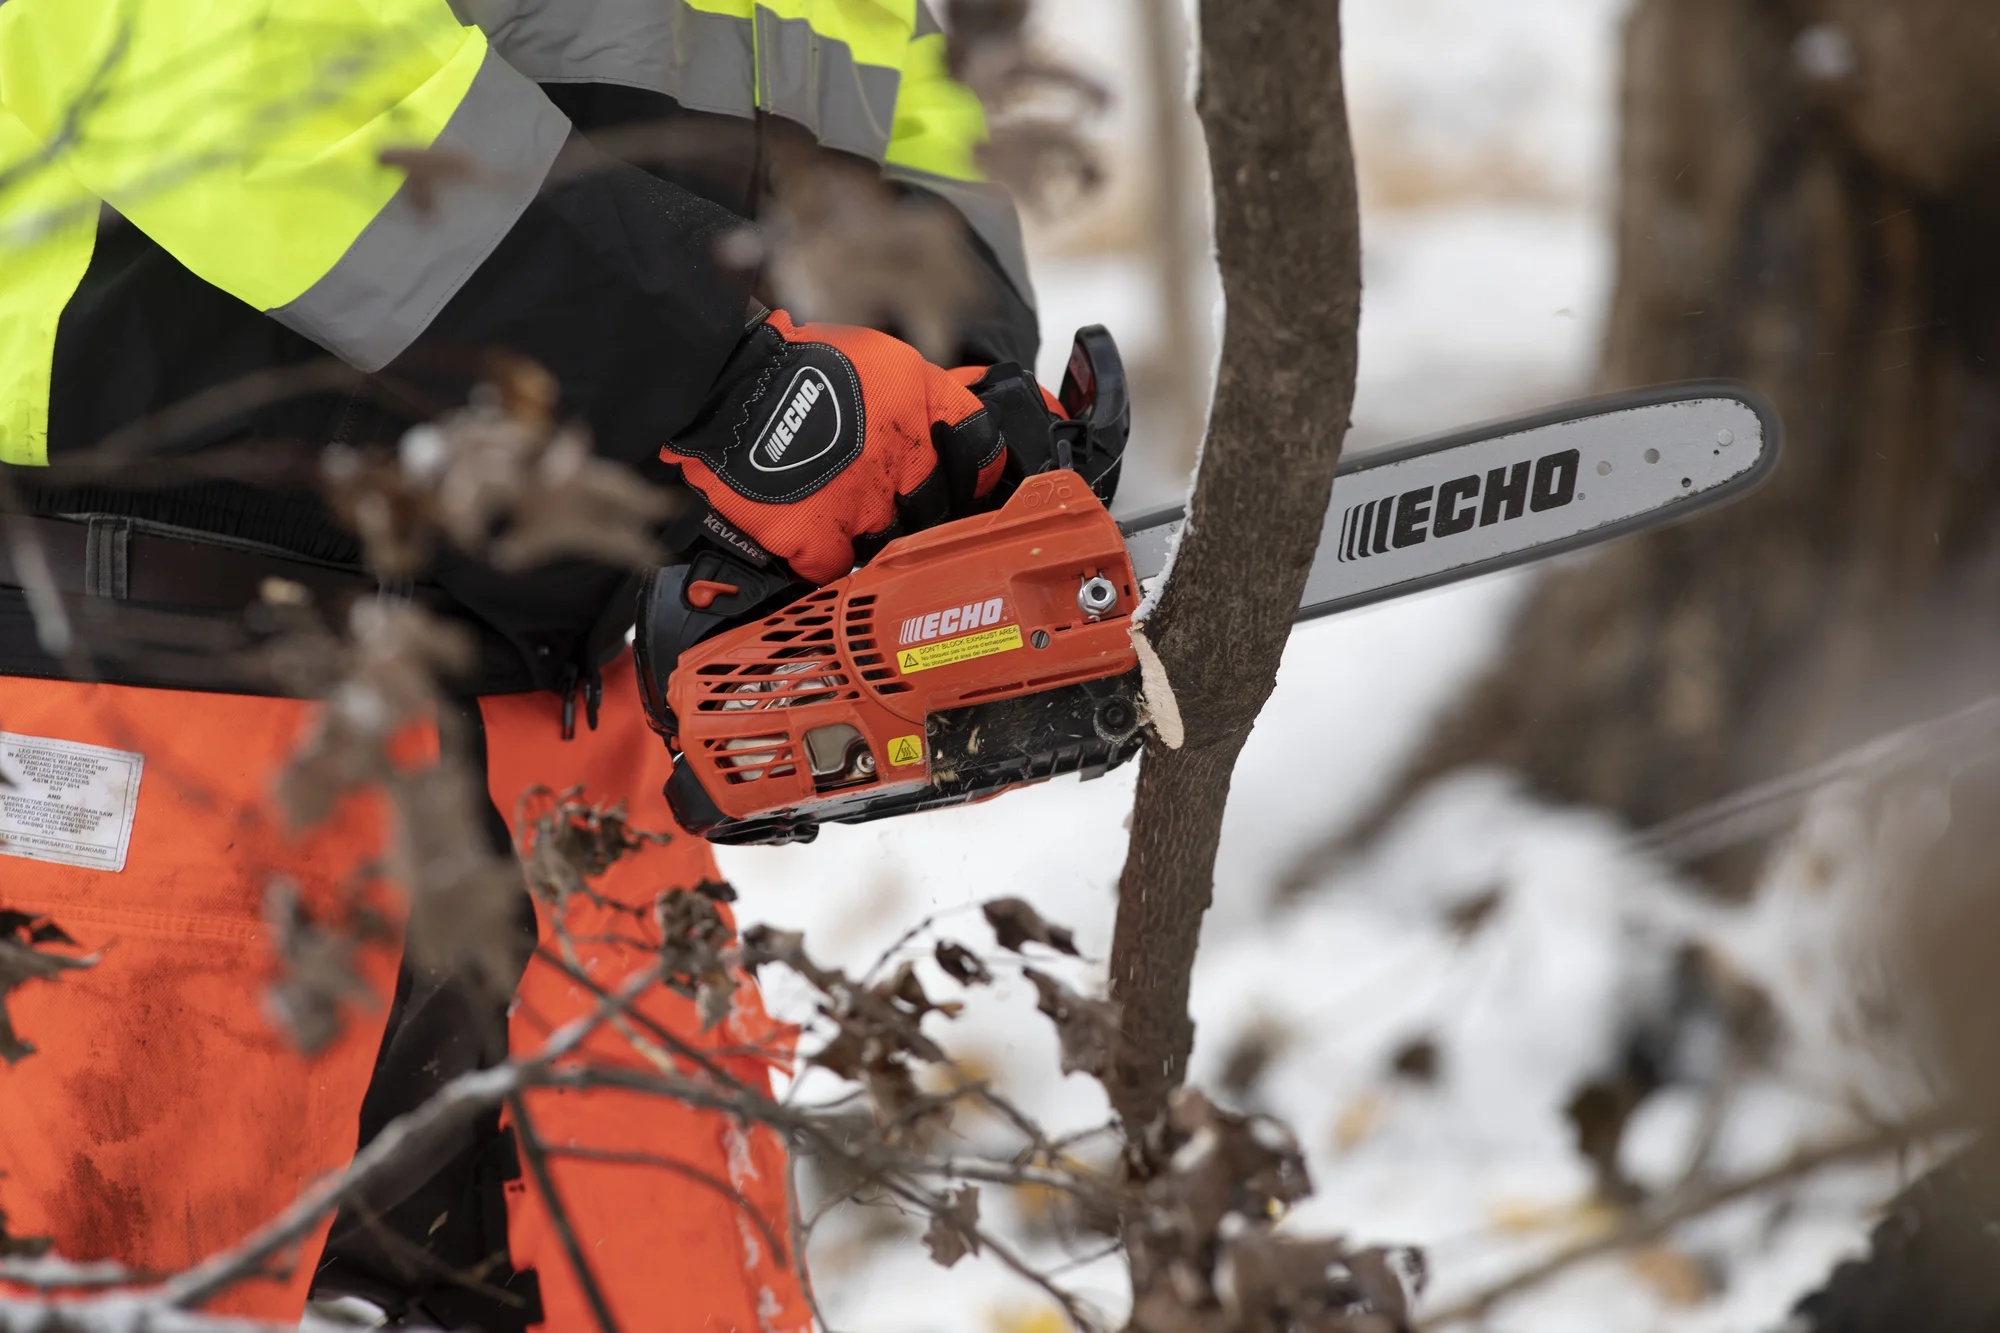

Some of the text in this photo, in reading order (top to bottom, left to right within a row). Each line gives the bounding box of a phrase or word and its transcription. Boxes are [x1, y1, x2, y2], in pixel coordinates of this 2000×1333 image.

[775, 378, 820, 447] ECHO
[1392, 448, 1580, 549] ECHO
[703, 513, 759, 558] KEVLAR
[921, 597, 1003, 640] ECHO
[919, 627, 1018, 655] DON'T BLOCK EXHAUST AREA
[931, 656, 954, 666] bloquear
[981, 646, 1000, 654] escape
[15, 752, 57, 764] ACCORDANCE
[32, 749, 68, 760] PROTECTIVE
[70, 755, 99, 764] GARMENT
[19, 759, 96, 775] STANDARD SPECIFICATION
[52, 769, 89, 780] PROTECTION
[70, 778, 90, 786] USERS
[4, 800, 24, 808] USERS
[32, 805, 72, 816] ACCORDANCE
[6, 795, 43, 806] PROTECTIVE
[43, 801, 65, 809] DEVICE
[4, 806, 36, 816] STANDARD
[62, 816, 100, 827] PROTECTIVE
[6, 812, 27, 820] DEVICE
[75, 845, 107, 855] STANDARD
